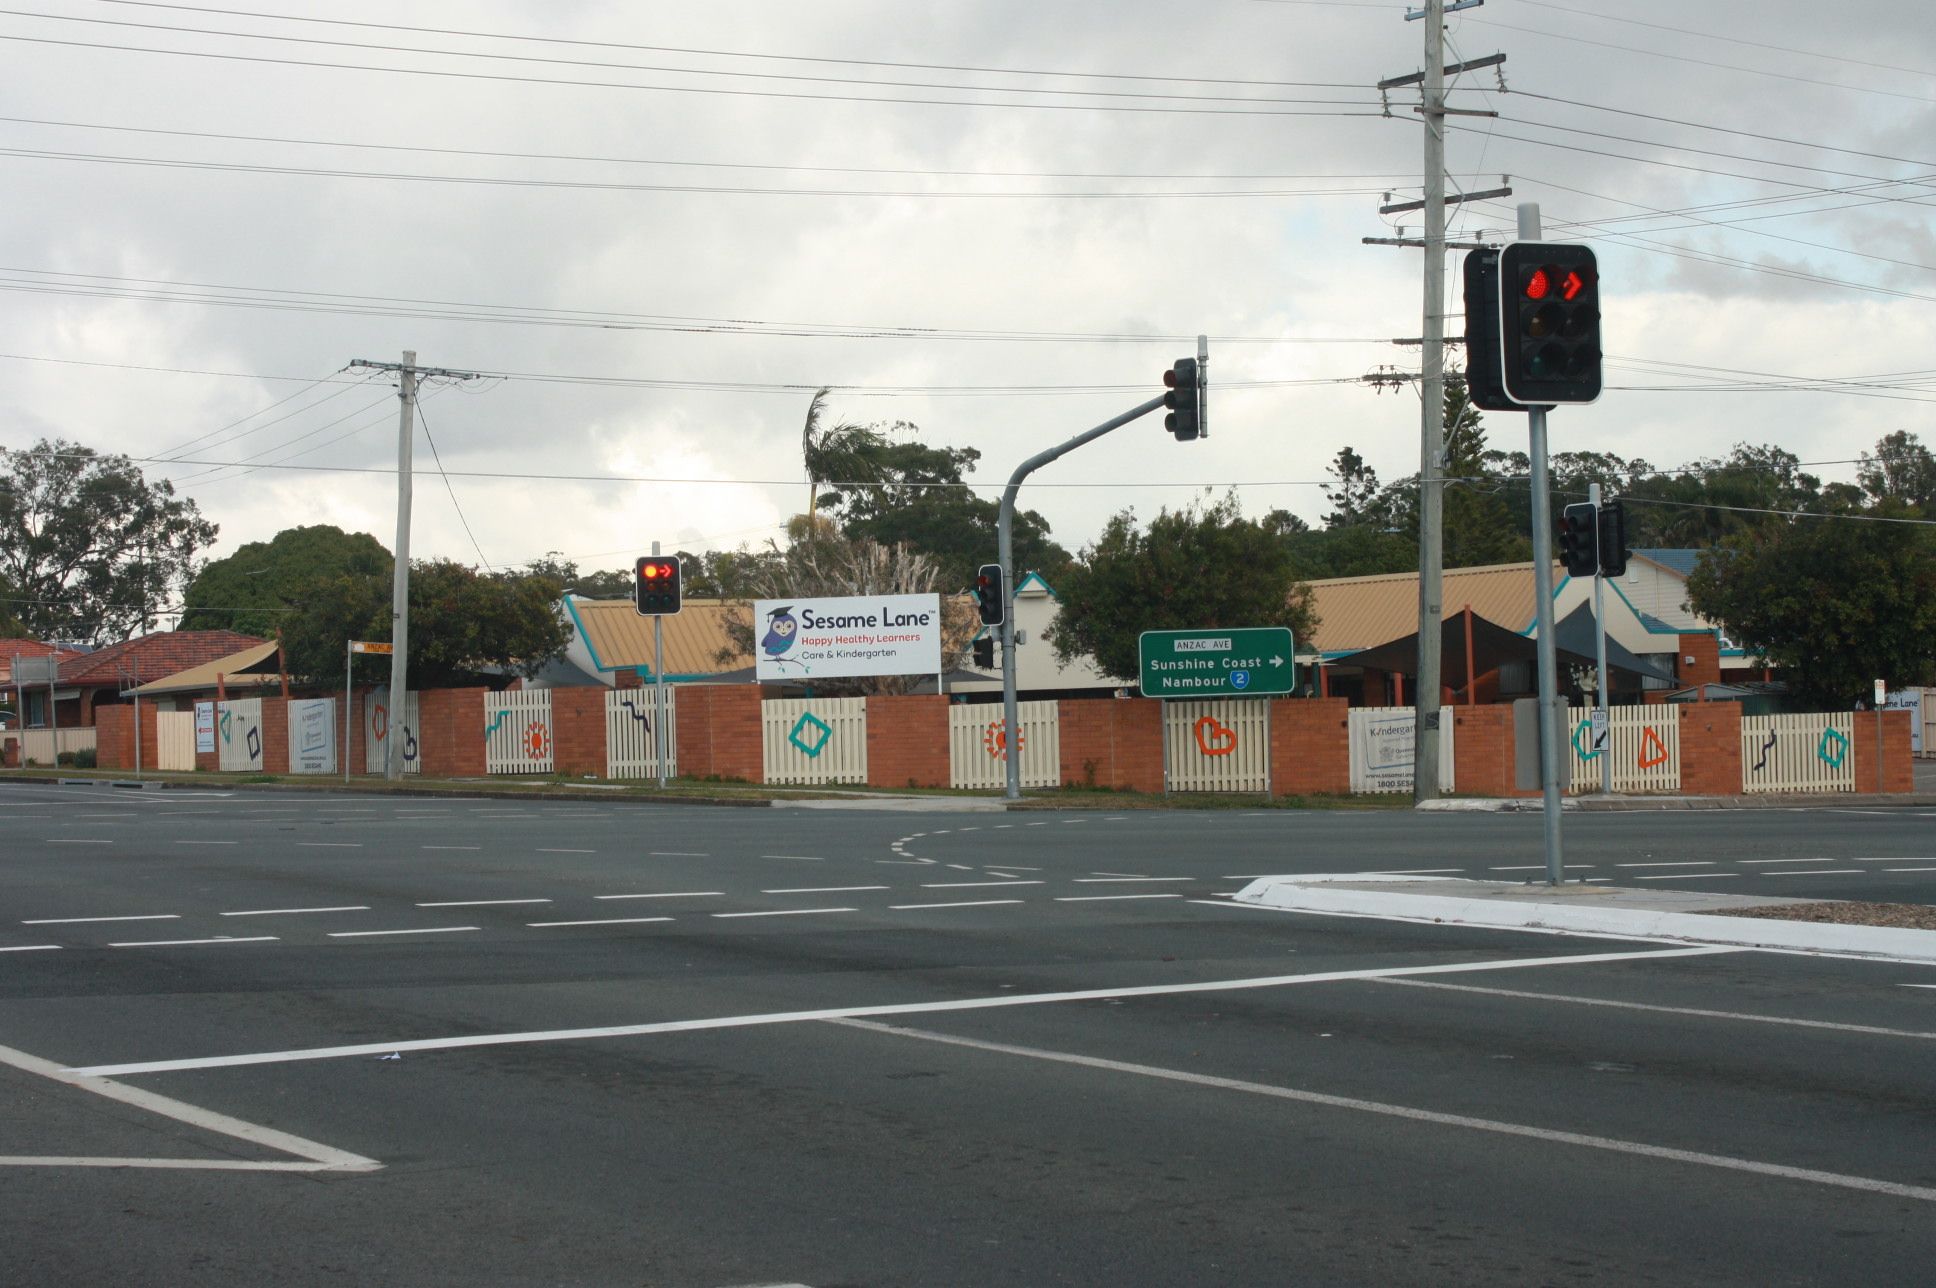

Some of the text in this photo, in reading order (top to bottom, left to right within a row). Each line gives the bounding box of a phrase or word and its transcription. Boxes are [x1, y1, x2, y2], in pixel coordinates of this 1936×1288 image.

[802, 608, 877, 629] Sesame
[883, 606, 930, 627] Lane
[801, 633, 921, 647] Happy Healthy Learners
[1177, 640, 1230, 650] ANZAC AVE
[802, 649, 897, 660] Care & Kindergarten
[1151, 656, 1261, 671] Sunshine Coast
[1162, 677, 1226, 688] Nambour
[1236, 673, 1245, 684] 2
[1900, 698, 1918, 708] Lane
